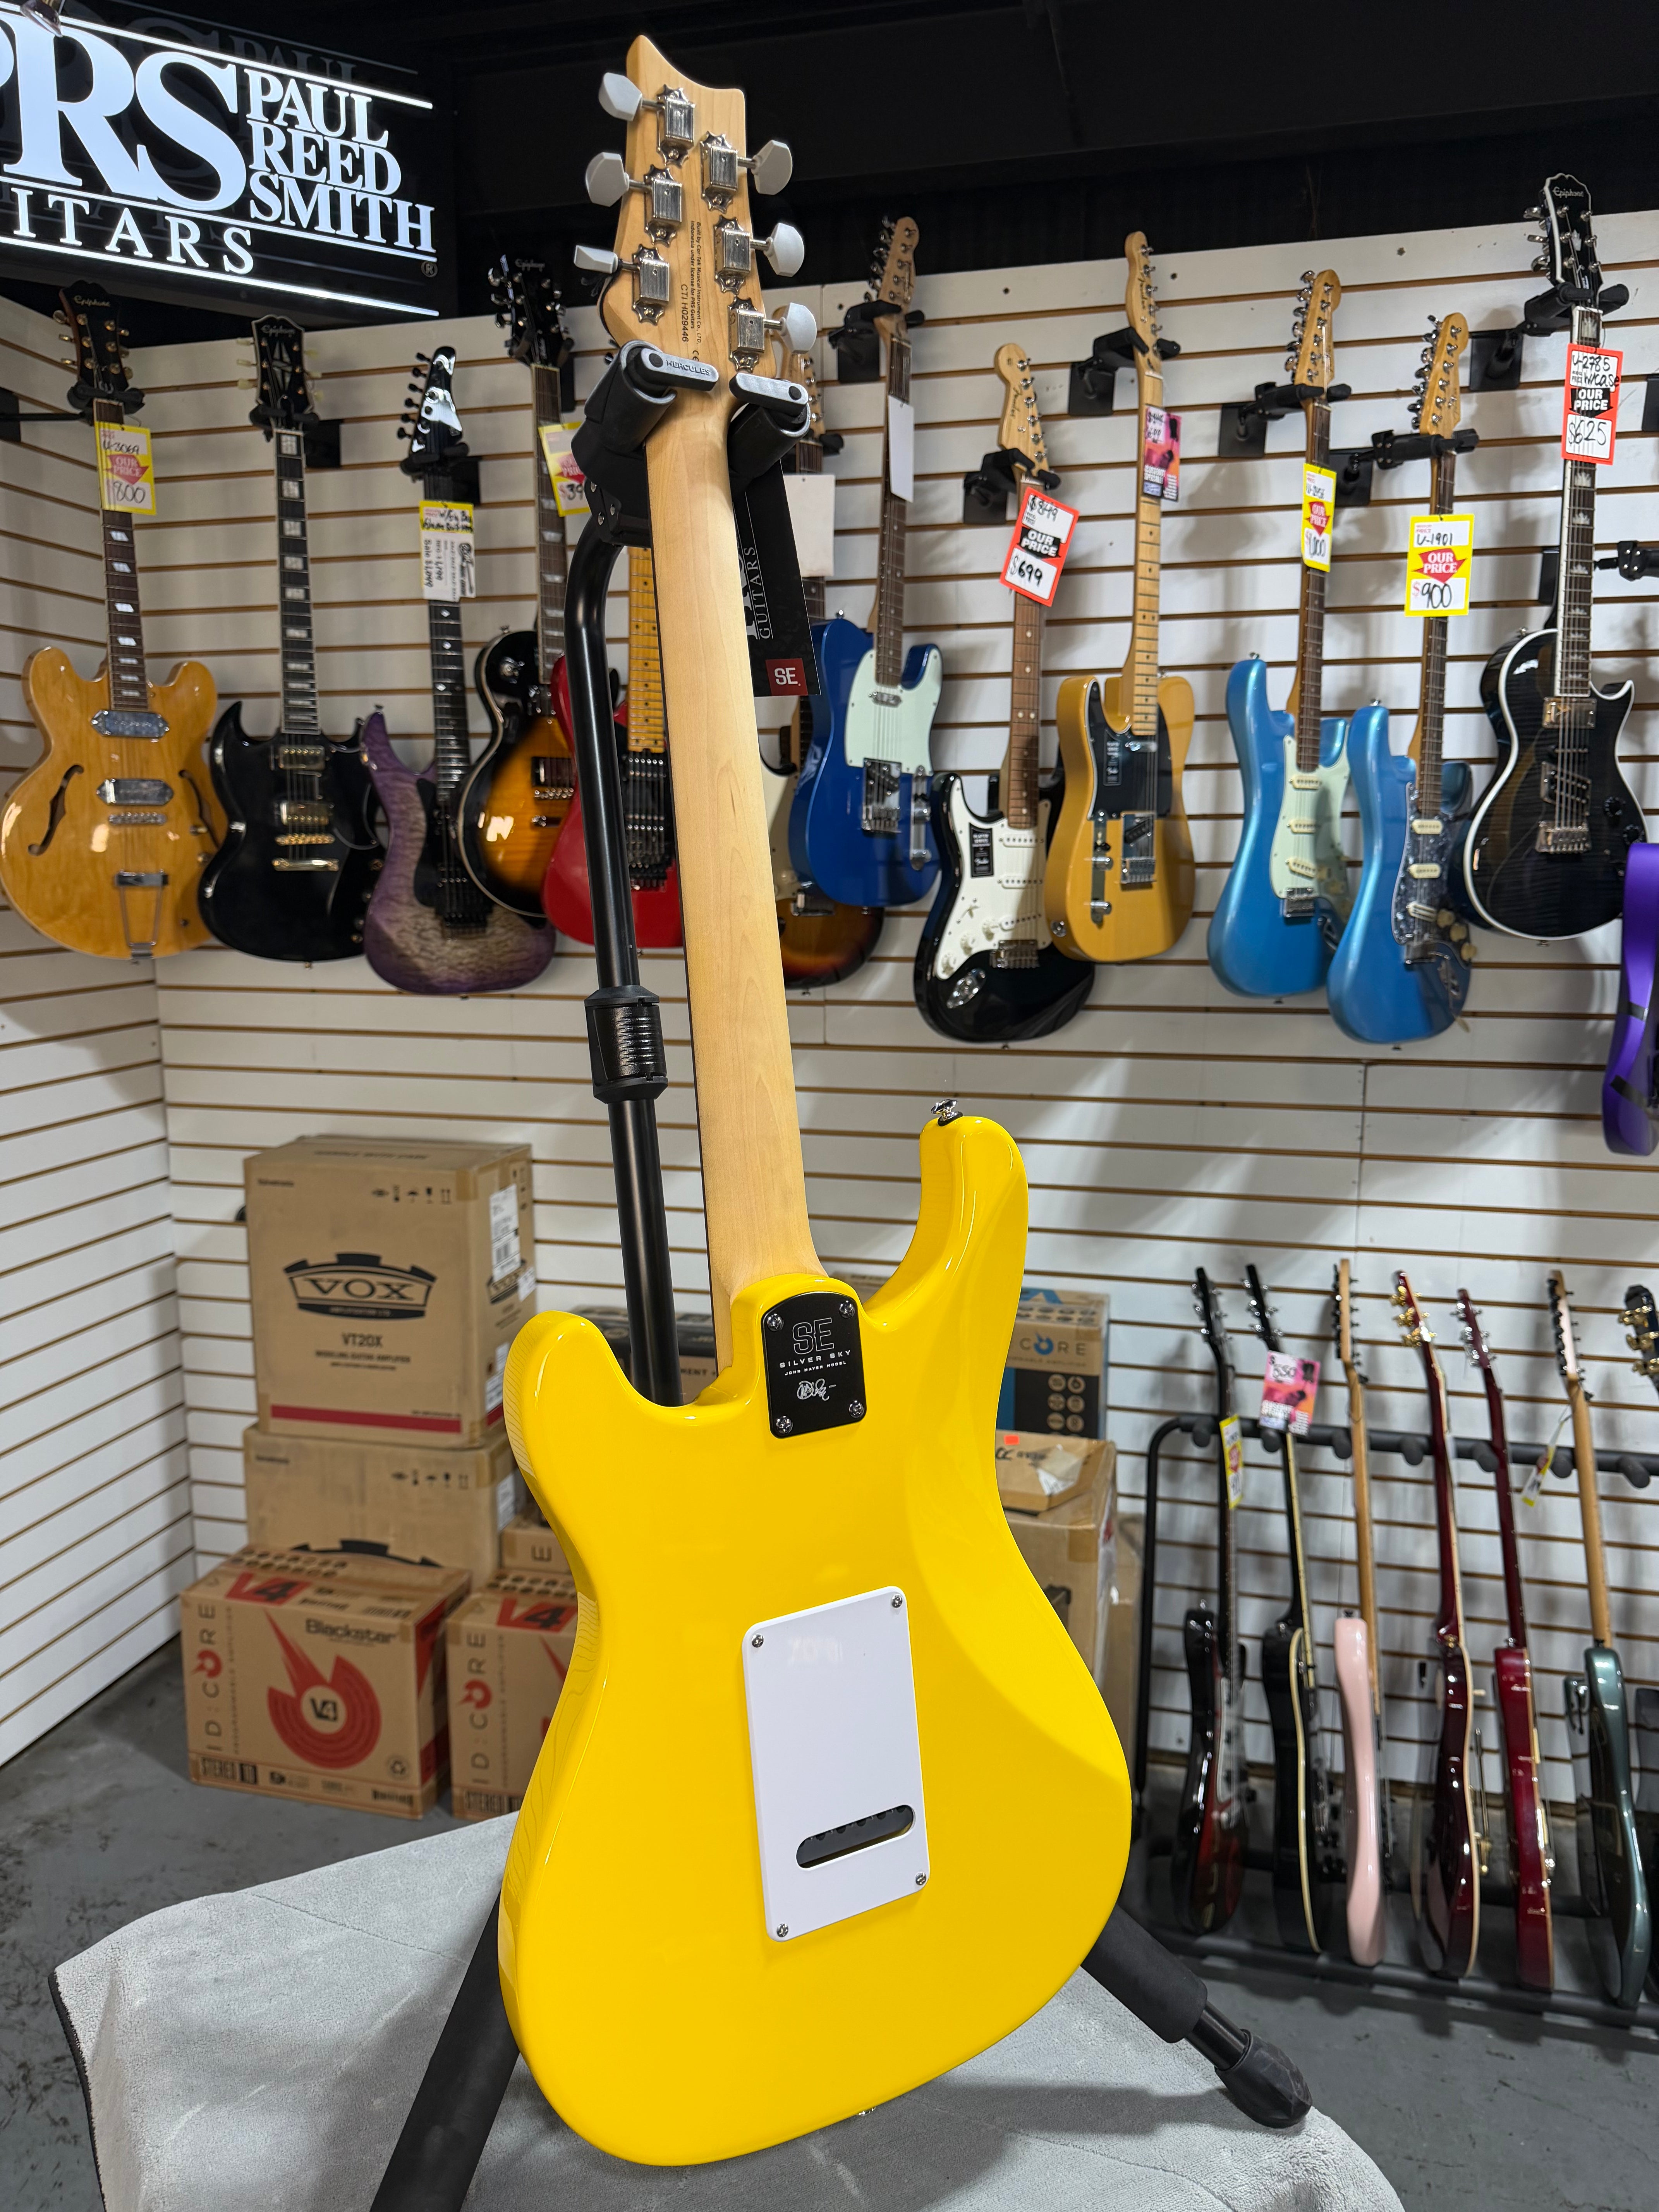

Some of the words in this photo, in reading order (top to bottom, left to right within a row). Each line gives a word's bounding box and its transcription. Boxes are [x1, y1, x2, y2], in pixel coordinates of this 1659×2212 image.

[0, 13, 246, 211] RS
[244, 68, 388, 147] PAUL
[247, 119, 402, 196] REED
[1552, 186, 1584, 199] Epiphone
[250, 172, 436, 253] SMITH
[666, 360, 711, 376] HERCULES
[1578, 388, 1603, 400] OUR
[1573, 400, 1609, 411] PRICE
[1568, 419, 1607, 446] $625
[1020, 538, 1058, 557] PRICE
[1027, 529, 1054, 546] OUR
[1423, 562, 1458, 574] PRICE
[1427, 552, 1454, 563] OUR
[1009, 555, 1042, 587] $699
[744, 547, 771, 639] GUITARS
[303, 1277, 414, 1301] VOX
[341, 1332, 383, 1347] VT20X
[792, 1317, 834, 1355] SE
[780, 1355, 822, 1368] SILVER
[830, 1350, 851, 1358] SKY
[305, 1618, 397, 1644] Blackstar
